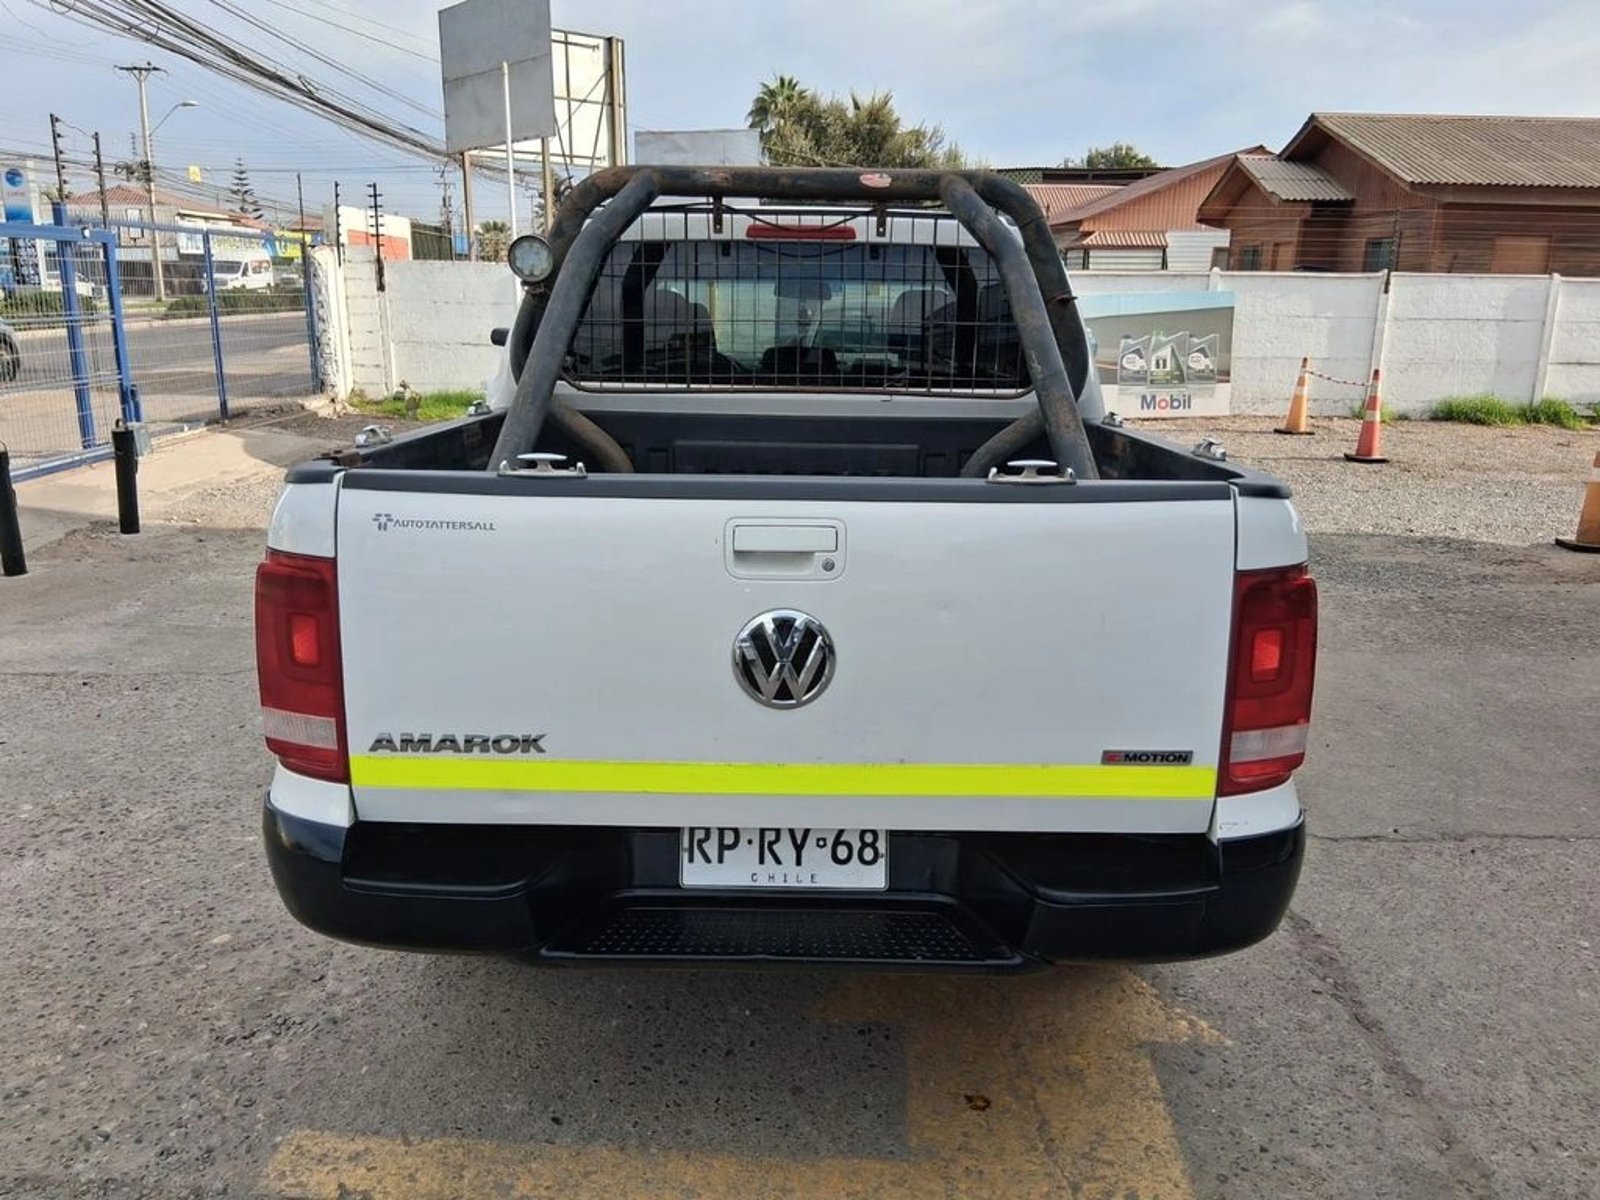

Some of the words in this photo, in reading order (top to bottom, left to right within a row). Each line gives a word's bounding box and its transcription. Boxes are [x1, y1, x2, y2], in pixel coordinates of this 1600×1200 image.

[1141, 394, 1191, 410] Mobil
[393, 519, 496, 531] AUTOTATTERSALL
[731, 608, 836, 710] VW
[368, 732, 549, 754] AMAROK
[751, 872, 818, 884] CHILE
